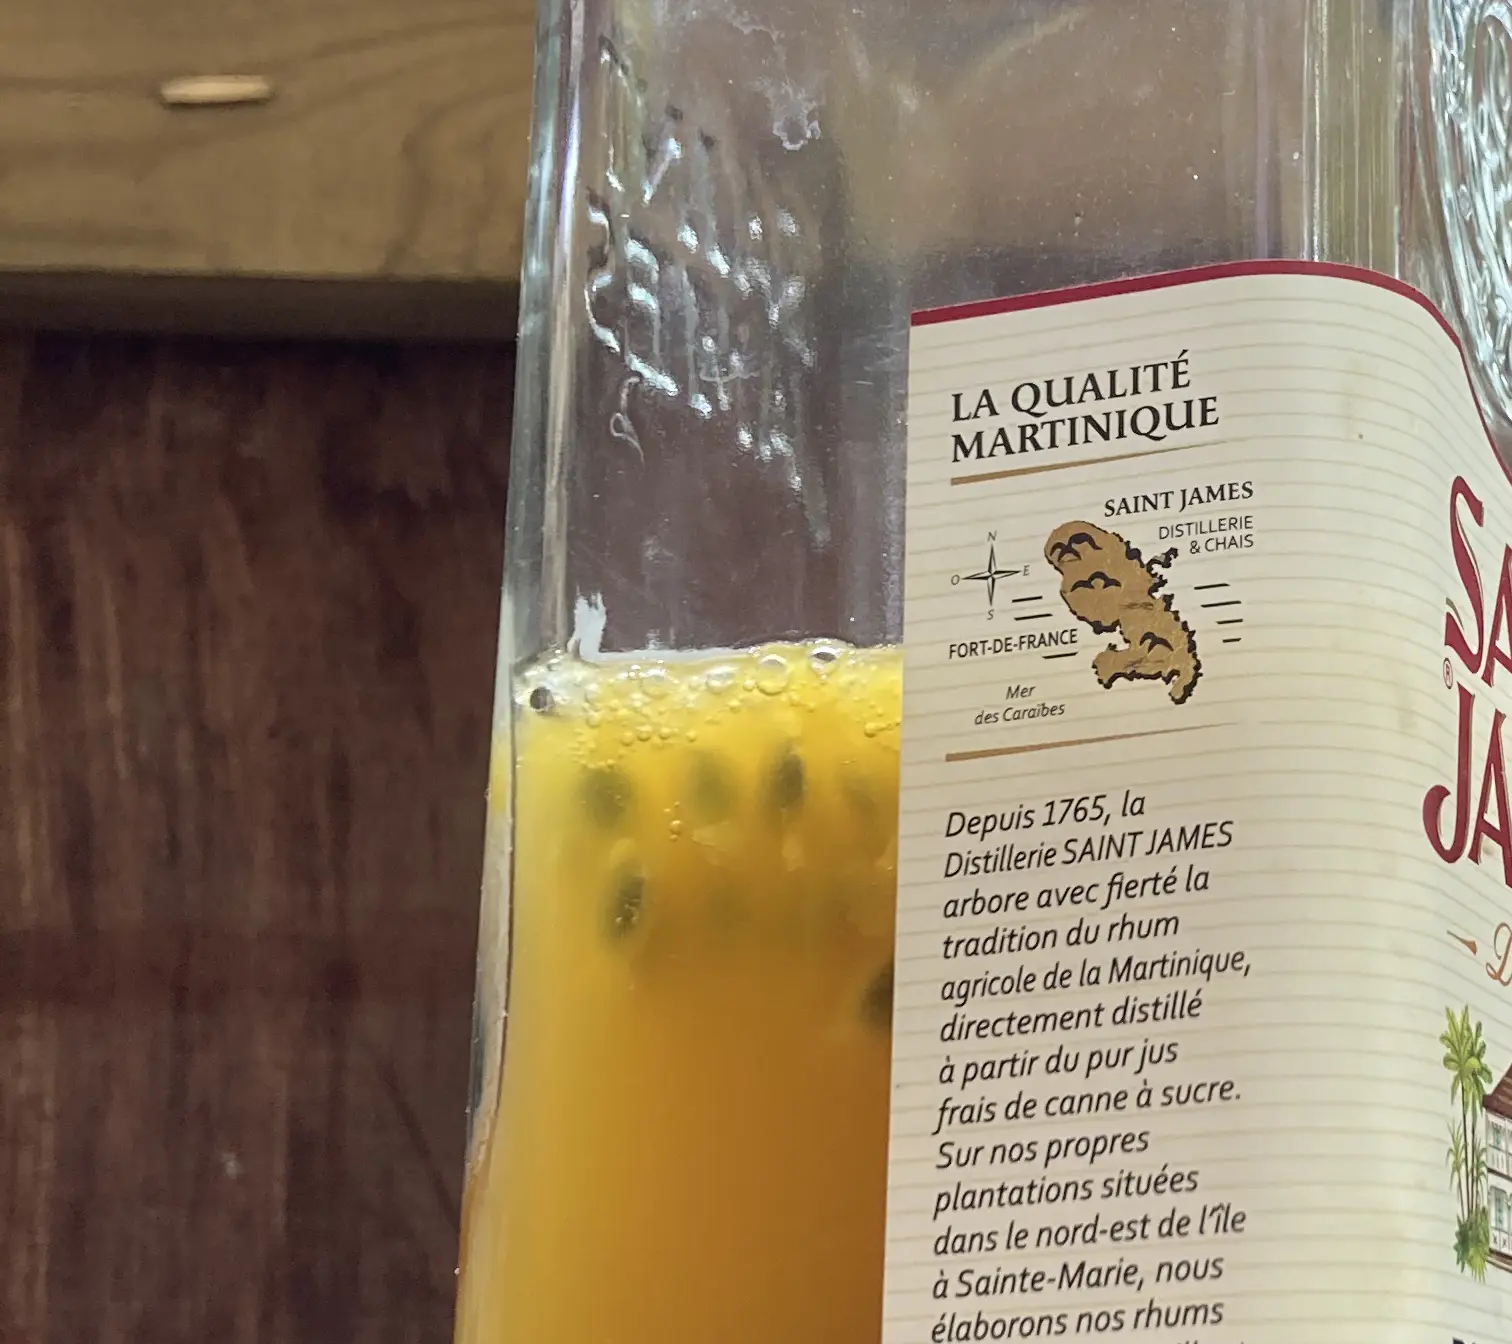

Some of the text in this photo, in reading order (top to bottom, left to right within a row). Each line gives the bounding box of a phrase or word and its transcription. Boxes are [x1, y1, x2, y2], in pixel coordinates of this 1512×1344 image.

[951, 349, 1191, 423] LA QUALITÉ
[951, 396, 1220, 463] MARTINIQUE
[1104, 480, 1254, 518] SAINT JAMES
[987, 531, 997, 542] N
[1158, 515, 1254, 540] DISTILLERIE
[1189, 534, 1254, 554] & CHAIS
[1023, 565, 1030, 576] E
[948, 628, 1078, 660] FORT-DE-FRANCE
[974, 702, 1065, 725] des Caraïbes
[1006, 684, 1036, 700] Mer
[944, 789, 1146, 841] Depuis 1765, la
[944, 820, 1234, 878] Distillerie SAINT JAMES
[943, 864, 1210, 918] arbore avec fierté la
[943, 913, 1180, 959] tradition du rhum
[940, 949, 1251, 1008] agricole de la Martinique,
[939, 988, 1202, 1042] directement distillé
[938, 1038, 1179, 1091] à partir du pur jus
[932, 1079, 1241, 1135] frais de canne à sucre.
[935, 1129, 1150, 1169] Sur nos propres
[933, 1165, 1199, 1221] plantations situées
[933, 1226, 997, 1255] dans
[1005, 1221, 1029, 1250] le
[1036, 1213, 1150, 1247] nord-est
[1158, 1208, 1189, 1237] de
[933, 1257, 1224, 1300] à Sainte-Marie, nous
[931, 1299, 1224, 1344] élaborons nos rhums
